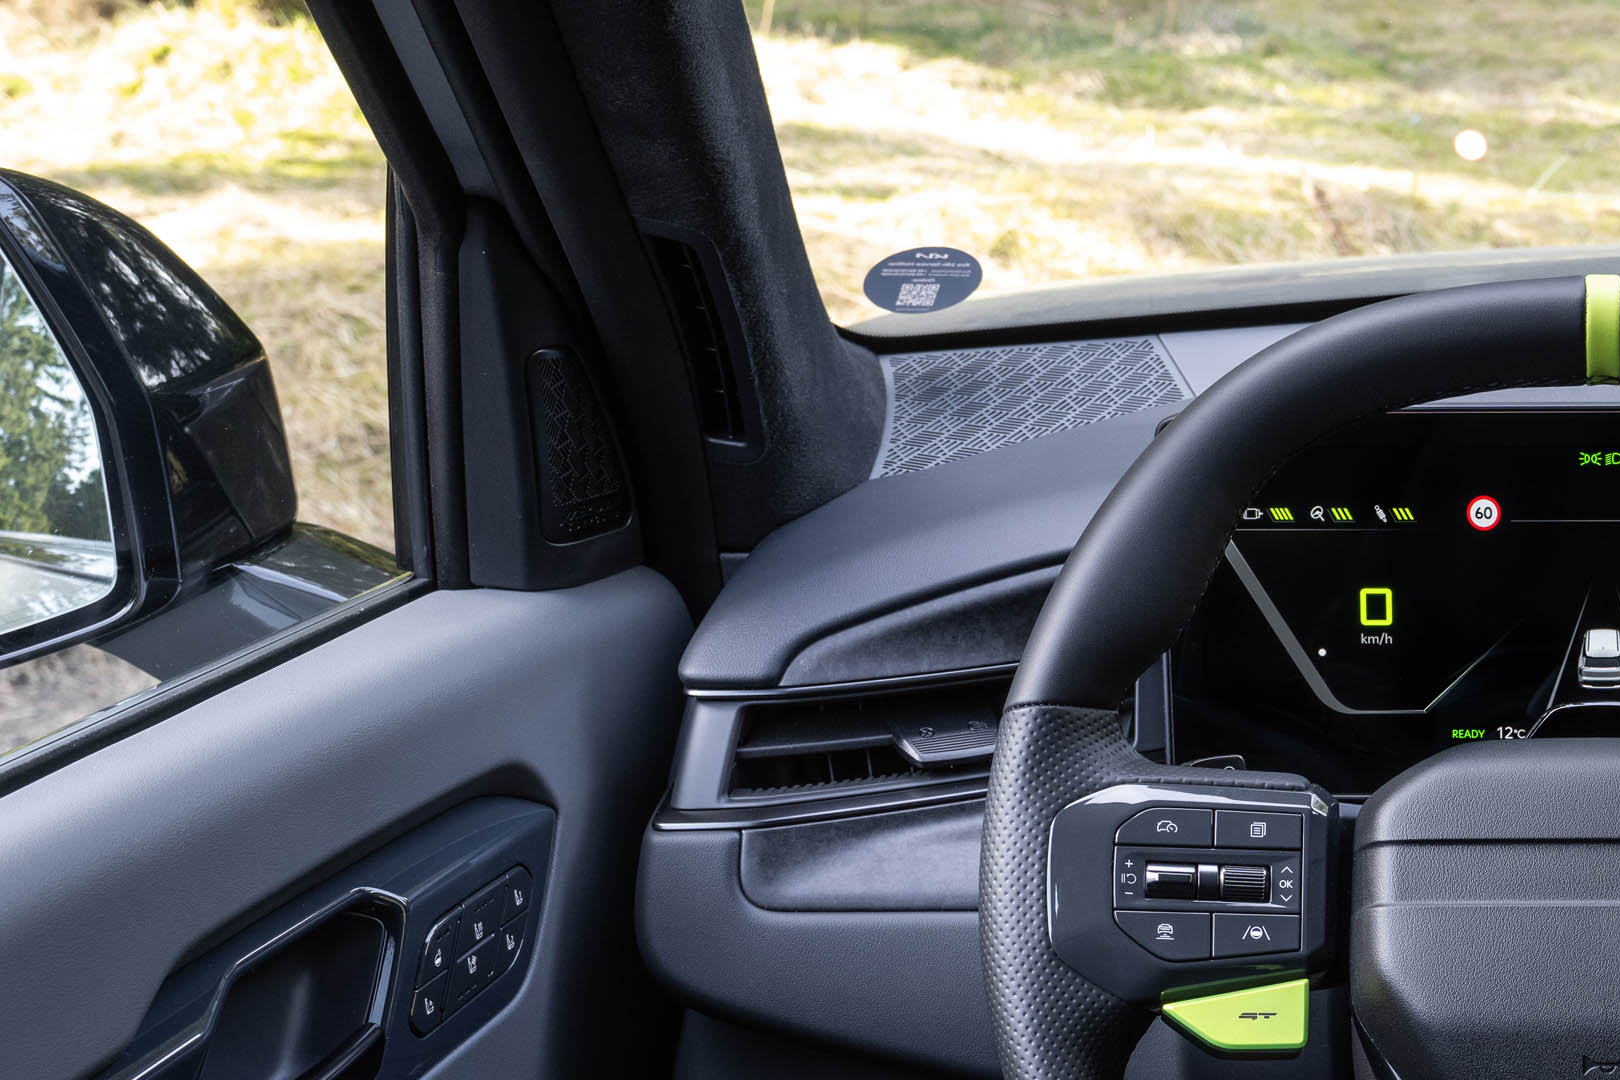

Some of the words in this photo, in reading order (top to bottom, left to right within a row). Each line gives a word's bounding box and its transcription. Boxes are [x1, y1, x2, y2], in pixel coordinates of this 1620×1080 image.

[1474, 506, 1493, 520] 60
[1360, 588, 1392, 626] 0
[1360, 632, 1393, 646] km/h
[1451, 729, 1486, 739] READY
[1278, 879, 1294, 889] OK
